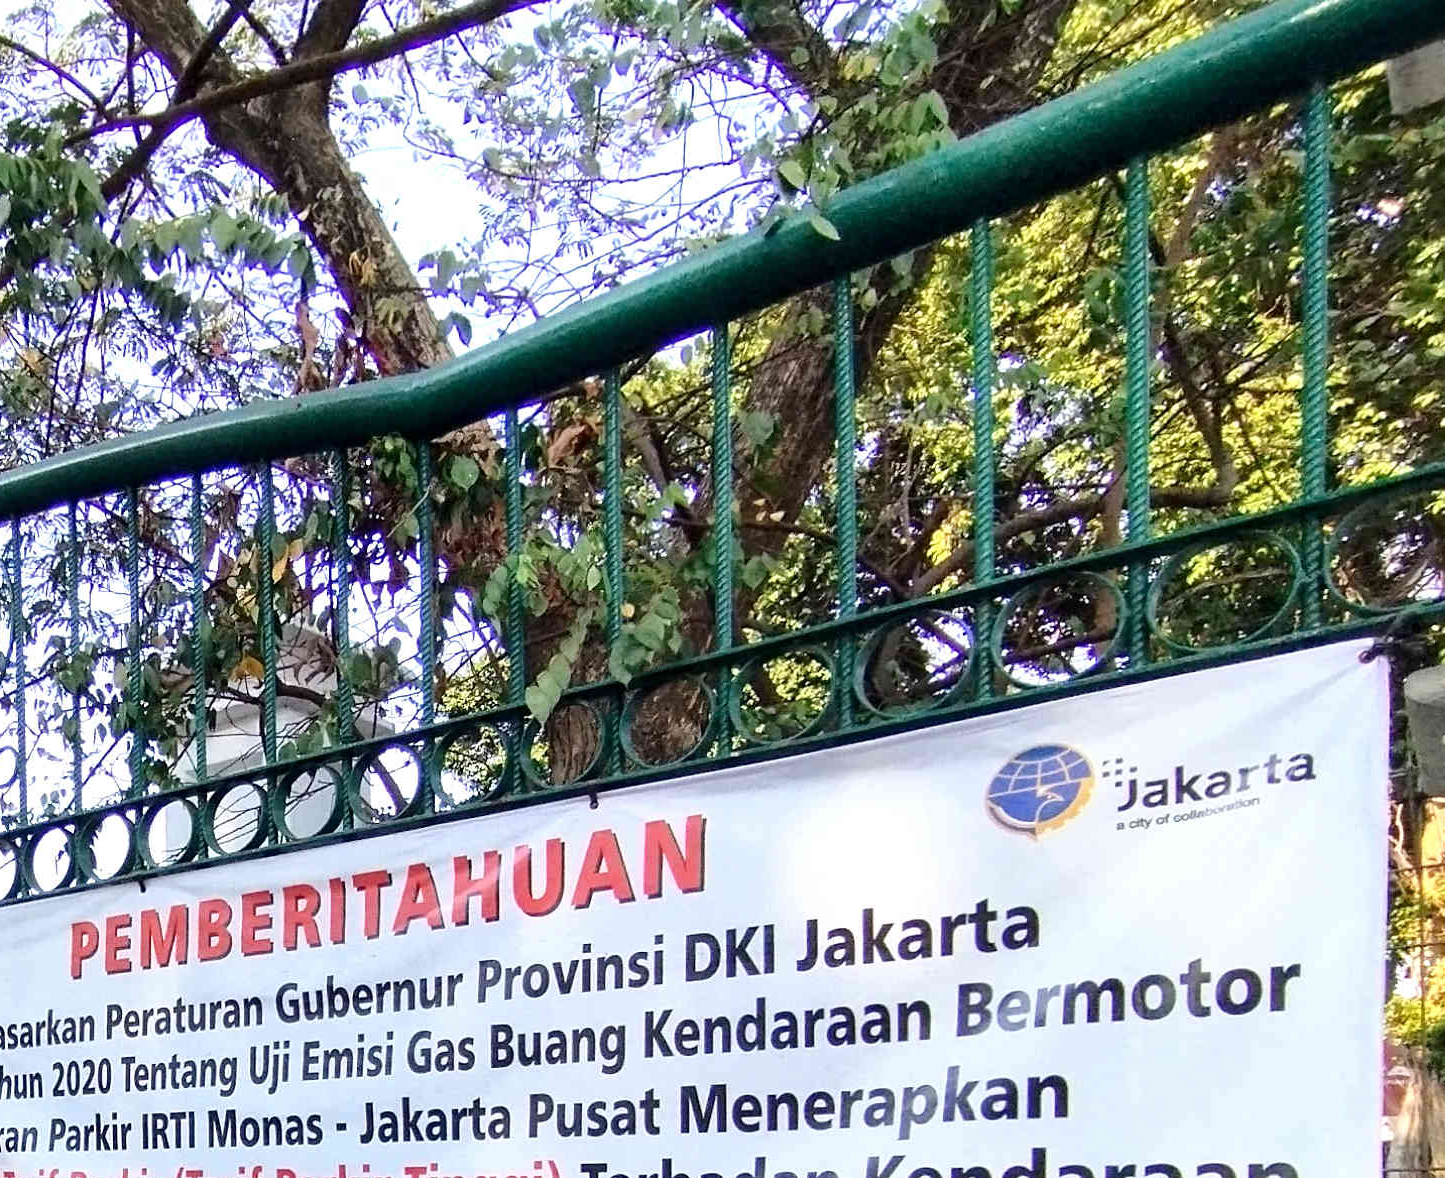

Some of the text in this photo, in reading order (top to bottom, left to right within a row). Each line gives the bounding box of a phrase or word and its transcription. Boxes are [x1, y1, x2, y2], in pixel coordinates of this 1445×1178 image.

[1116, 822, 1125, 830] a
[1129, 818, 1152, 829] city
[1156, 814, 1169, 824] of
[68, 815, 707, 981] PEMBERITAHUAN
[53, 1058, 111, 1097] 2020
[121, 1054, 237, 1097] Tentang
[250, 1040, 290, 1094] Uji
[303, 1031, 393, 1081] Emisi
[407, 1031, 475, 1074] Gas
[491, 1024, 625, 1074] Buang
[645, 997, 931, 1058] Kendaraan
[957, 959, 1301, 1037] Bermotor
[107, 997, 262, 1040] Peraturan
[276, 973, 463, 1023] Gubernur
[478, 934, 664, 1003] Provinsi
[686, 924, 774, 982] DKI
[797, 899, 1039, 971] Jakarta
[49, 1112, 131, 1152] Parkir
[142, 1111, 195, 1149] IRTI
[208, 1109, 323, 1148] Monas
[360, 1097, 510, 1144] Jakarta
[529, 1088, 660, 1138] Pusat
[681, 1066, 1068, 1140] Menerapkan
